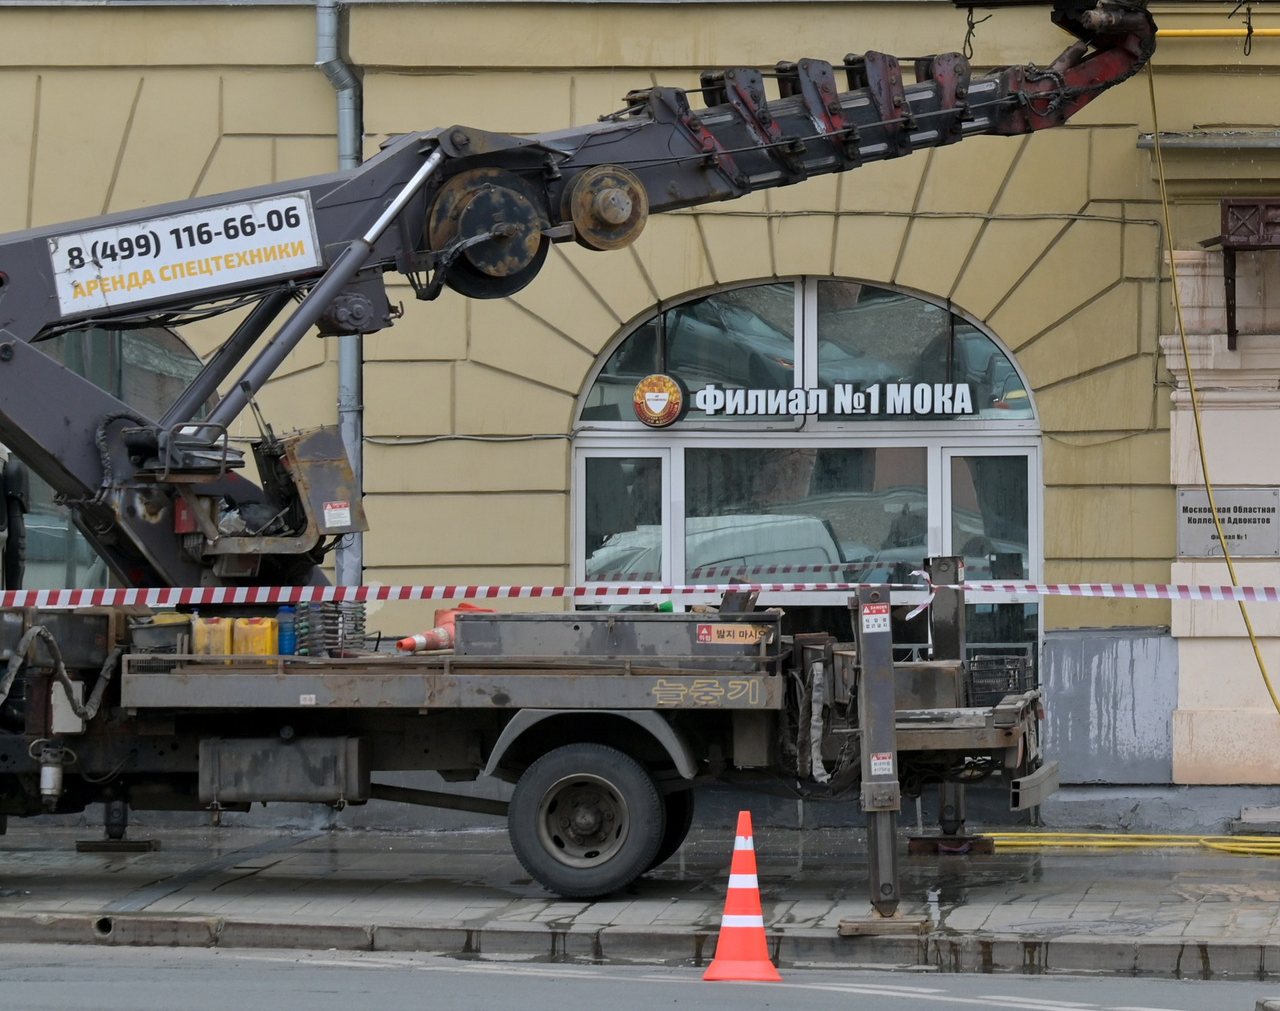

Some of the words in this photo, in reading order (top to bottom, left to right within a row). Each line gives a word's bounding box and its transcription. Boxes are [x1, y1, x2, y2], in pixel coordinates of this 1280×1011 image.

[67, 247, 85, 269] 8
[91, 230, 161, 269] (499)
[169, 206, 301, 249] 116-66-06
[73, 269, 156, 299] АРЕНДА
[159, 240, 306, 281] СПЕЦТЕХНИКИ
[695, 384, 828, 415] Филиал
[886, 383, 973, 414] МОКА
[1182, 506, 1231, 514] Московкая
[1233, 506, 1276, 514] Областная
[1227, 517, 1271, 525] Адвокатов
